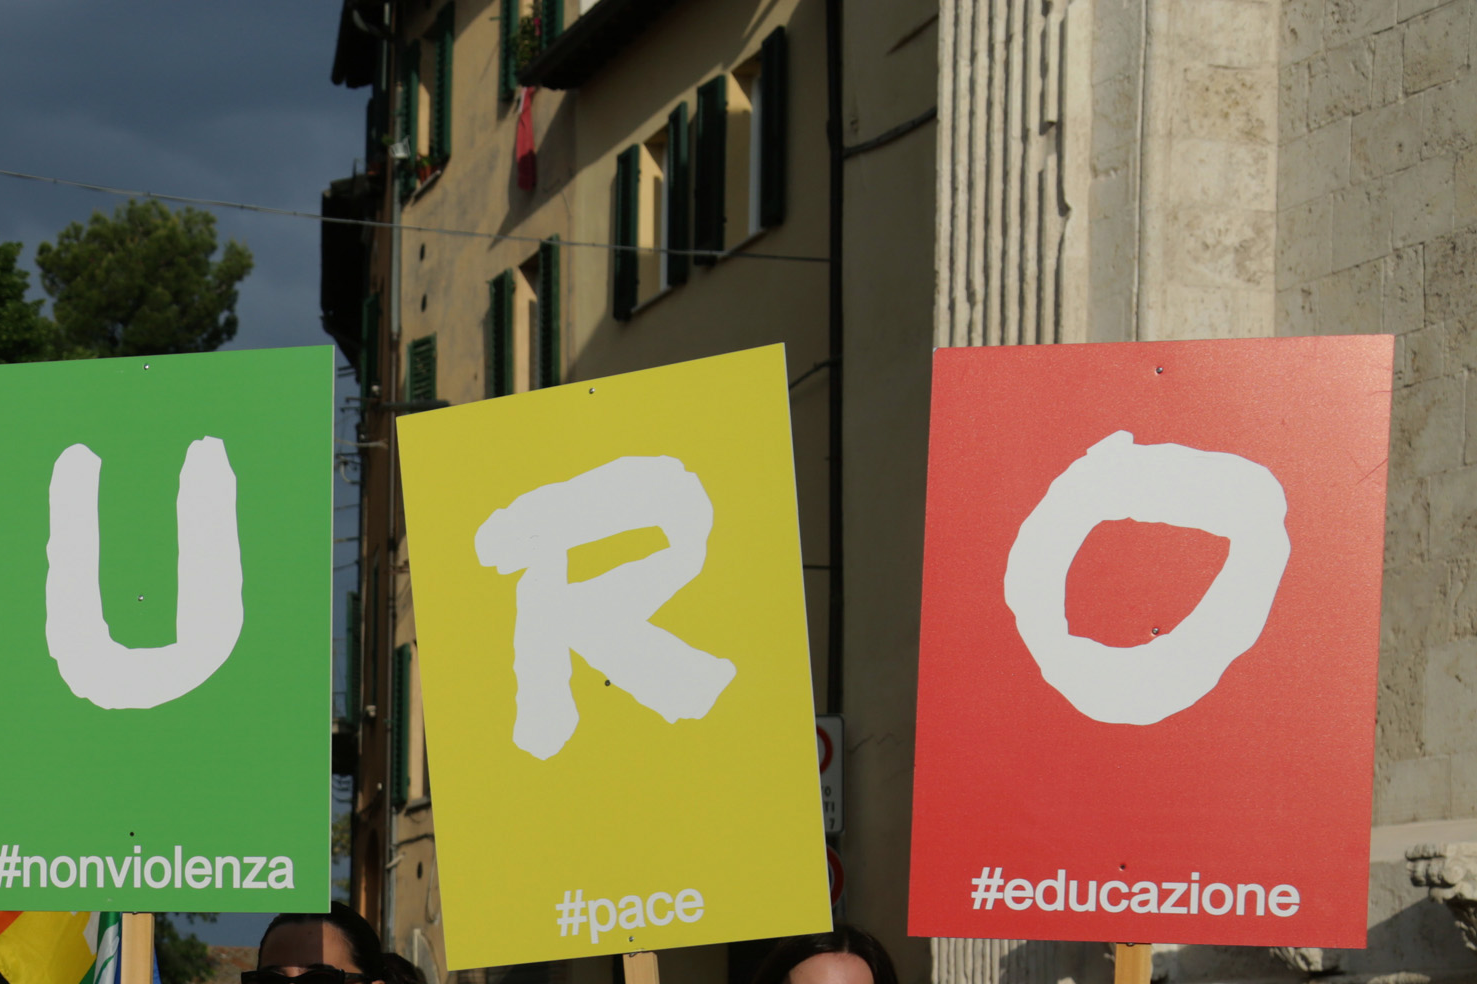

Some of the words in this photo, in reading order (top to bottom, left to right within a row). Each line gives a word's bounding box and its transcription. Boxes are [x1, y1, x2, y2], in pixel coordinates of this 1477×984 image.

[46, 436, 244, 710] U
[474, 454, 737, 761] R
[1003, 429, 1292, 726] O
[555, 888, 705, 944] #pace
[971, 866, 1301, 917] #educazione
